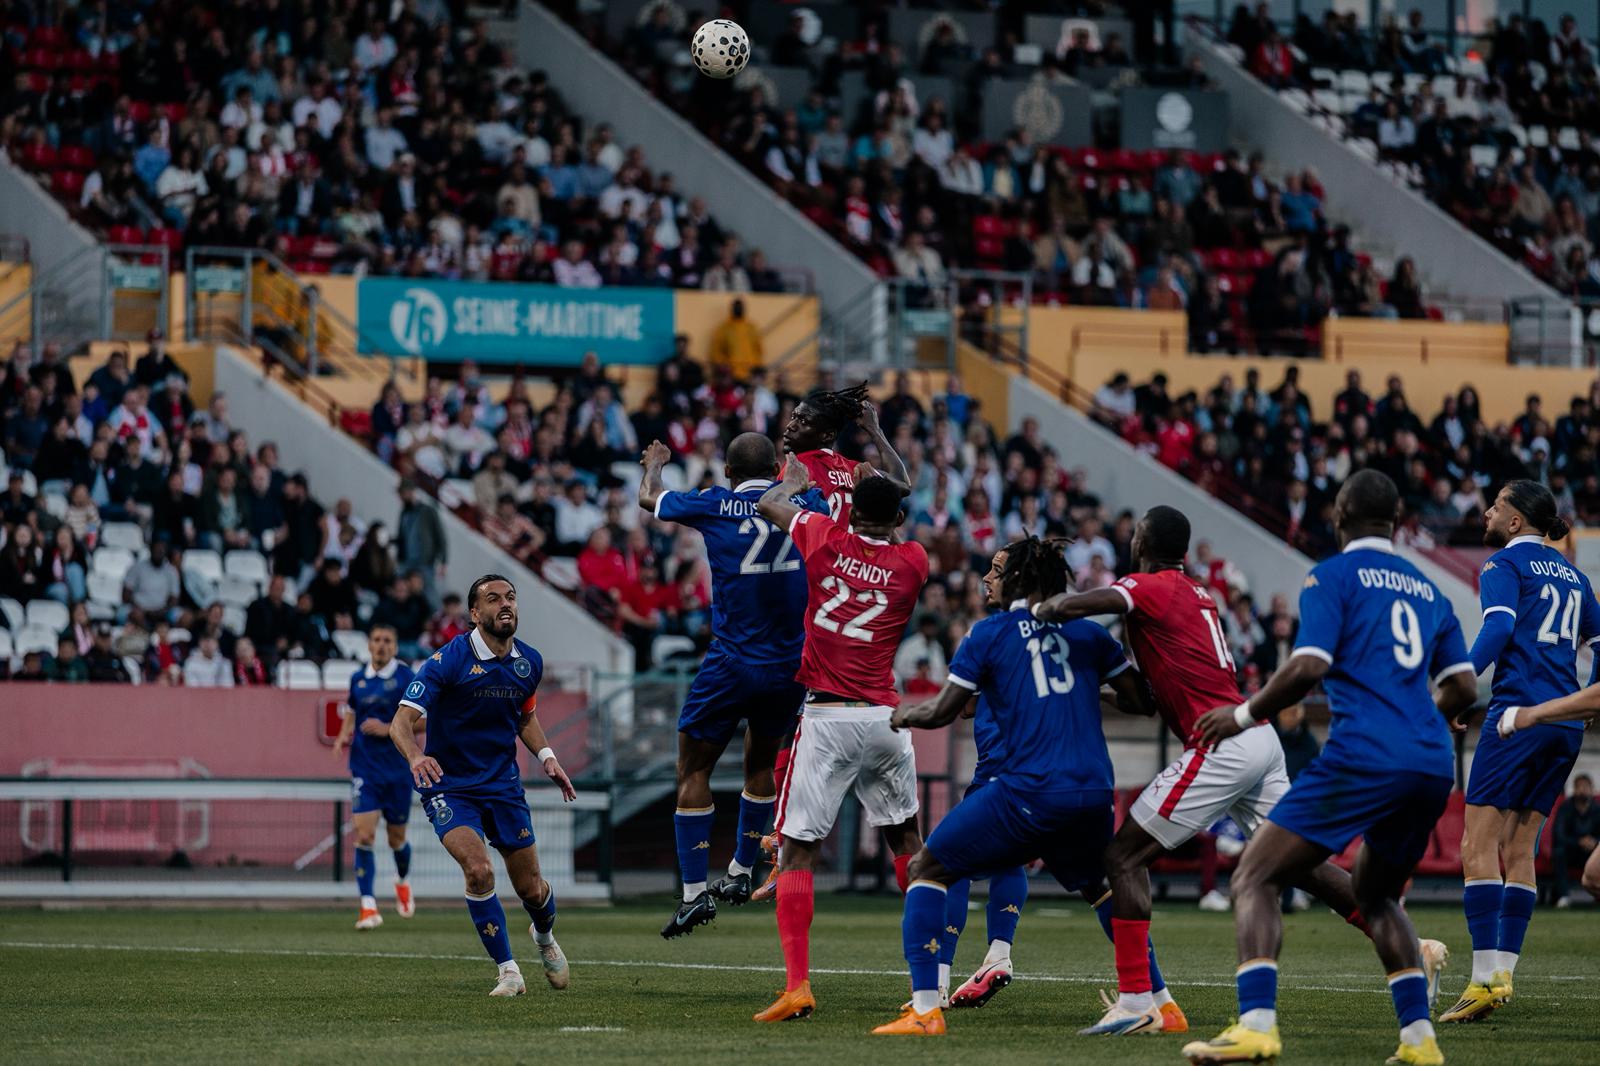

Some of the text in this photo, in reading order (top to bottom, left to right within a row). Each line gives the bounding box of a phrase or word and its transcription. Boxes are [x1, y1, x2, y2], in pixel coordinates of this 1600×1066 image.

[453, 296, 645, 341] SEINE-MARITIME
[738, 517, 801, 575] 22
[832, 552, 893, 587] MENDY
[1357, 567, 1435, 602] ODZOUMO
[1529, 560, 1582, 584] OUCHEN
[813, 575, 889, 643] 22
[1390, 599, 1424, 669] 9
[1536, 582, 1583, 650] 24
[1026, 632, 1075, 698] 13
[473, 688, 524, 698] VERSAILLES
